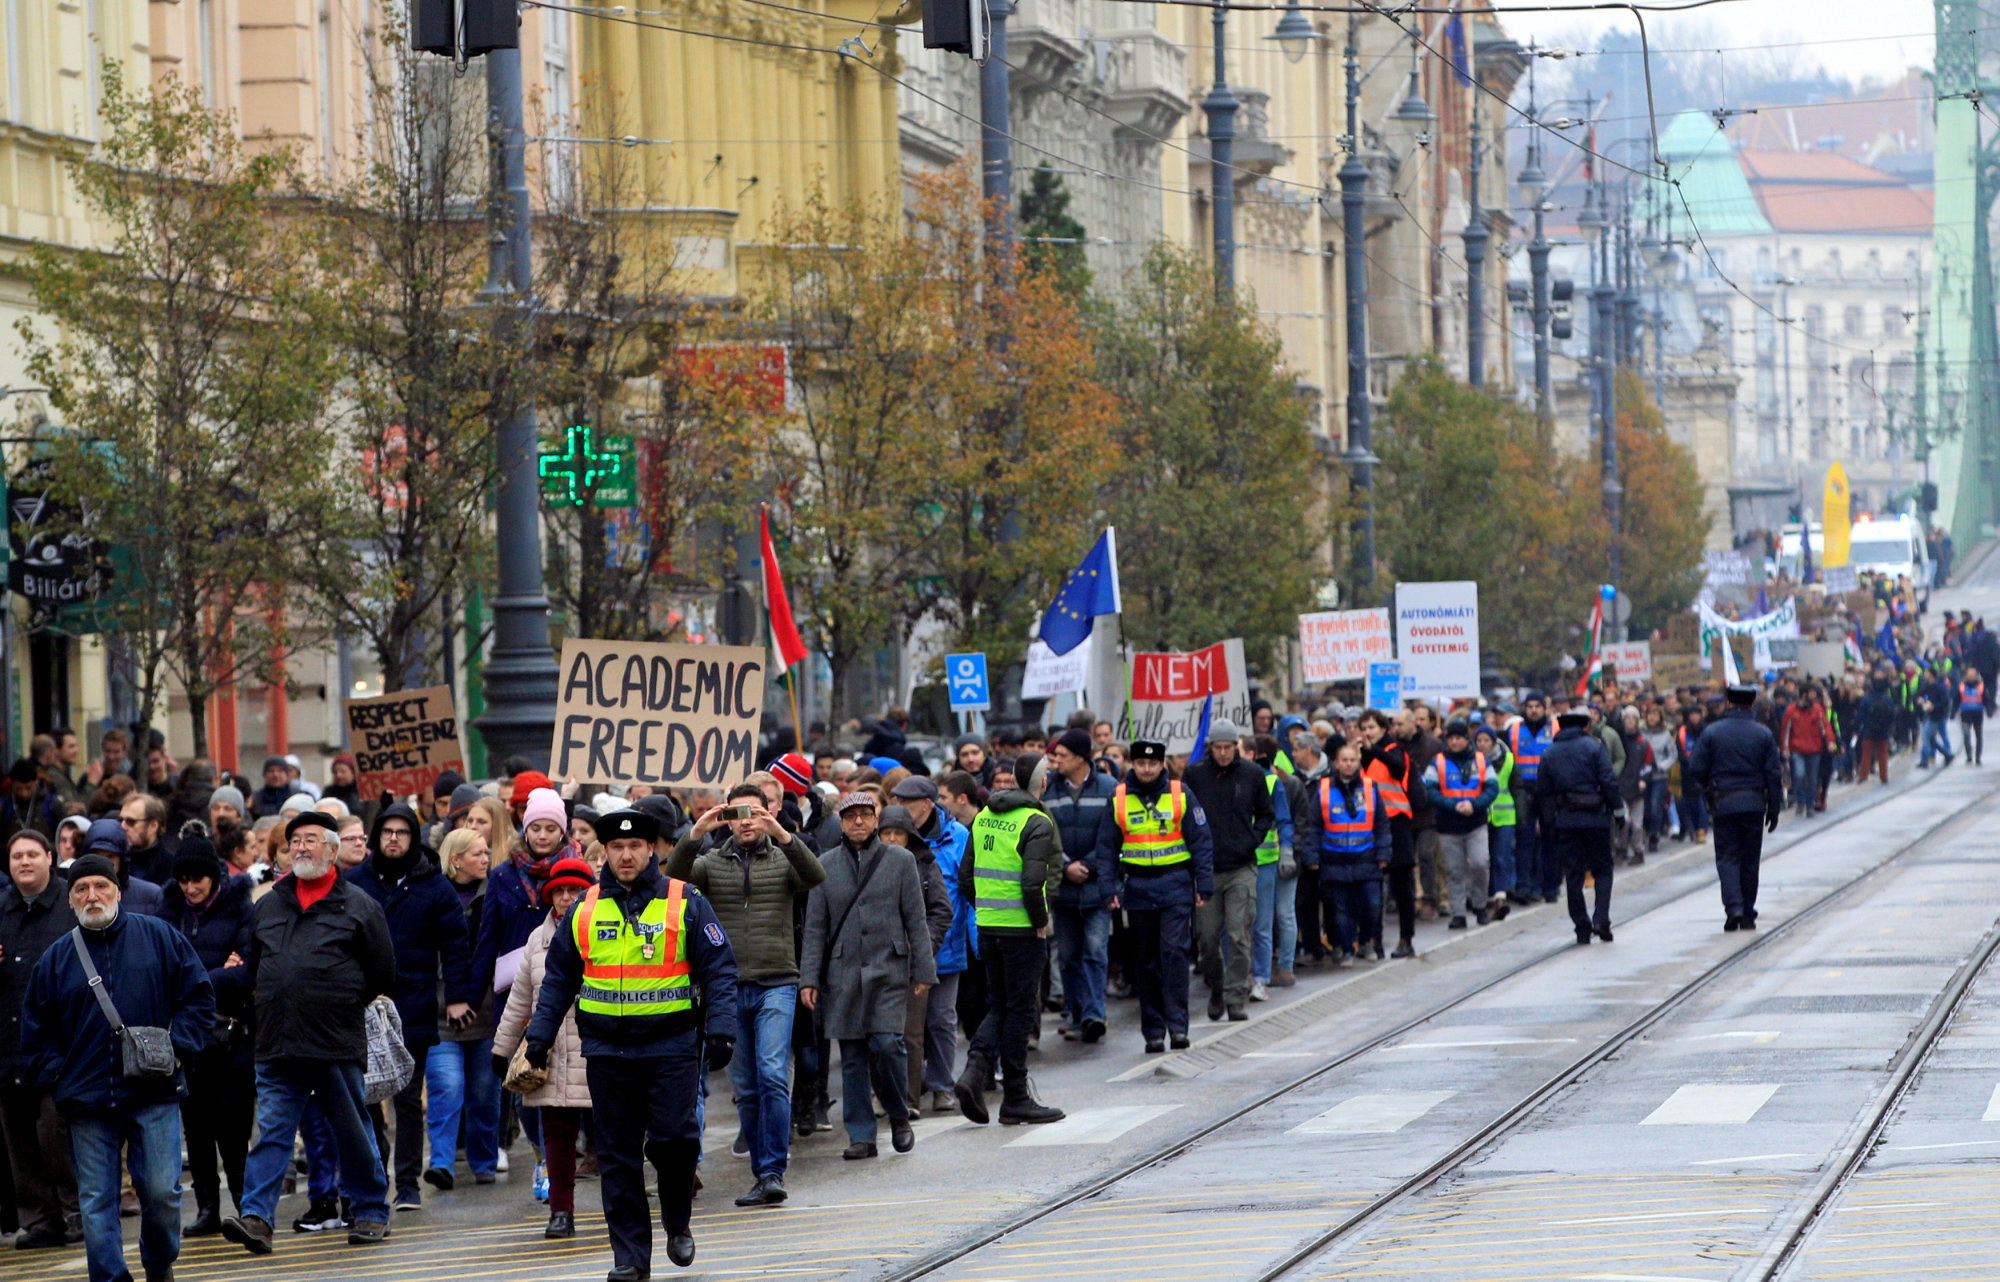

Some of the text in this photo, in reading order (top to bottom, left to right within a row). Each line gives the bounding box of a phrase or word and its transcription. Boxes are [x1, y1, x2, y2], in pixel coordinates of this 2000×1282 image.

[1401, 606, 1474, 619] AUTONÓMIÁT!
[1410, 625, 1464, 637] ÓVODÁTÓL
[1411, 643, 1469, 654] EGYETEMIG
[1145, 651, 1213, 696] NEM
[564, 652, 761, 719] ACADEMIC
[348, 697, 429, 730] RESPECT
[355, 745, 431, 772] EXPECT
[558, 714, 752, 783] FREEDOM
[984, 834, 995, 852] 30
[612, 990, 656, 1001] POLICE
[660, 987, 694, 1000] POLICE
